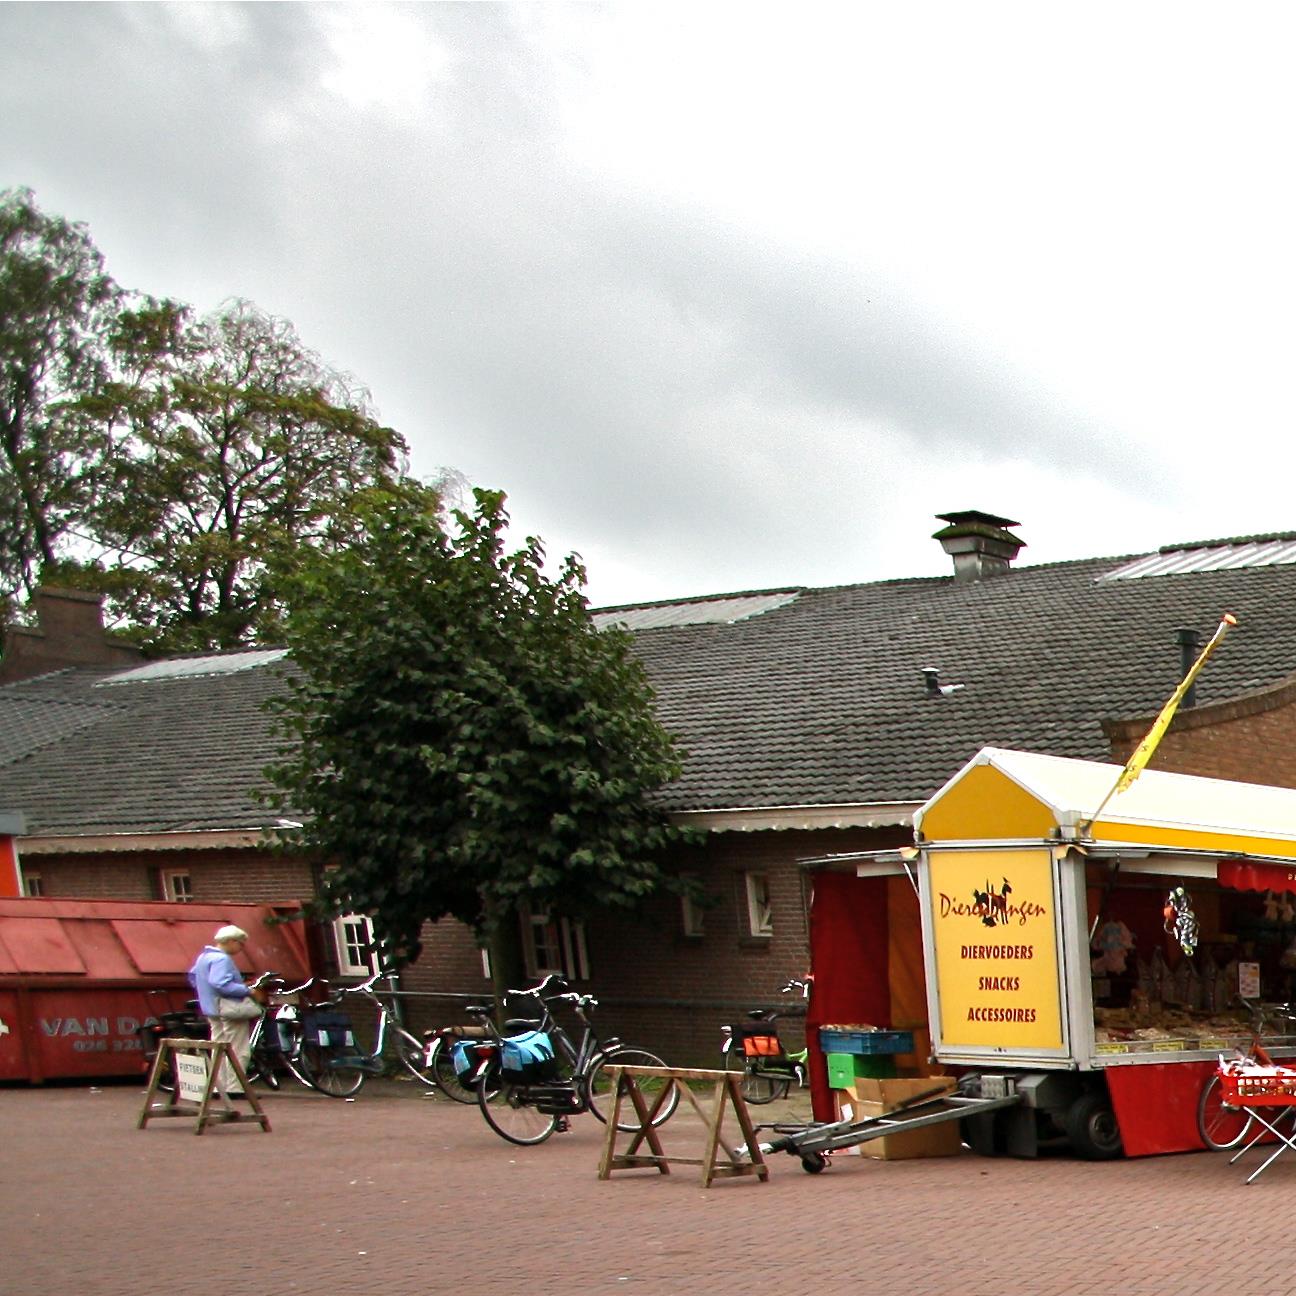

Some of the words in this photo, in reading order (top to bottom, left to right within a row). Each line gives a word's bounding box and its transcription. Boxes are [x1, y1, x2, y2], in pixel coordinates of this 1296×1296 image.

[961, 945, 1033, 960] DIERVOEDERS
[978, 977, 1020, 991] SNACKS
[967, 1007, 1036, 1023] ACCESSOIRES
[41, 1017, 110, 1036] VAN
